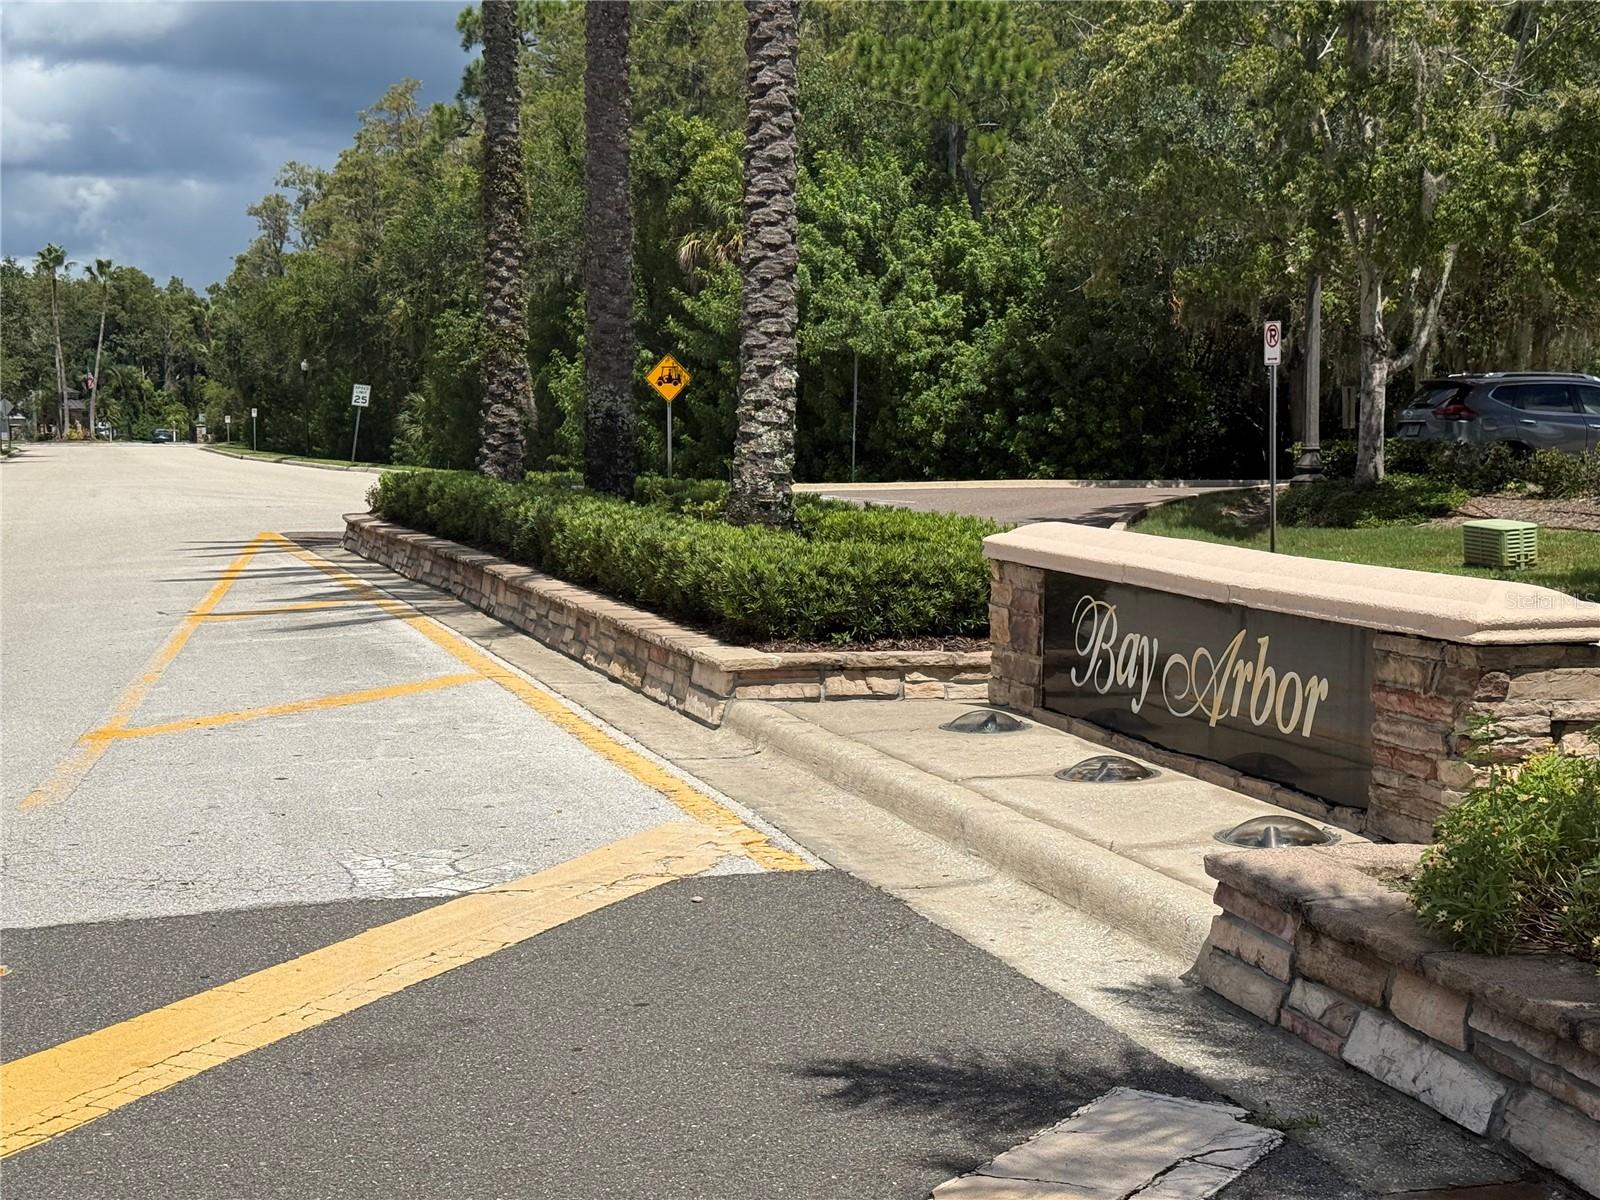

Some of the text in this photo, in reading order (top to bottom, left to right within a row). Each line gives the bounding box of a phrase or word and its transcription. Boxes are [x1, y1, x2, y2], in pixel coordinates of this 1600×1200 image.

[354, 395, 367, 404] 25
[1071, 594, 1329, 738] Bay Arbor
